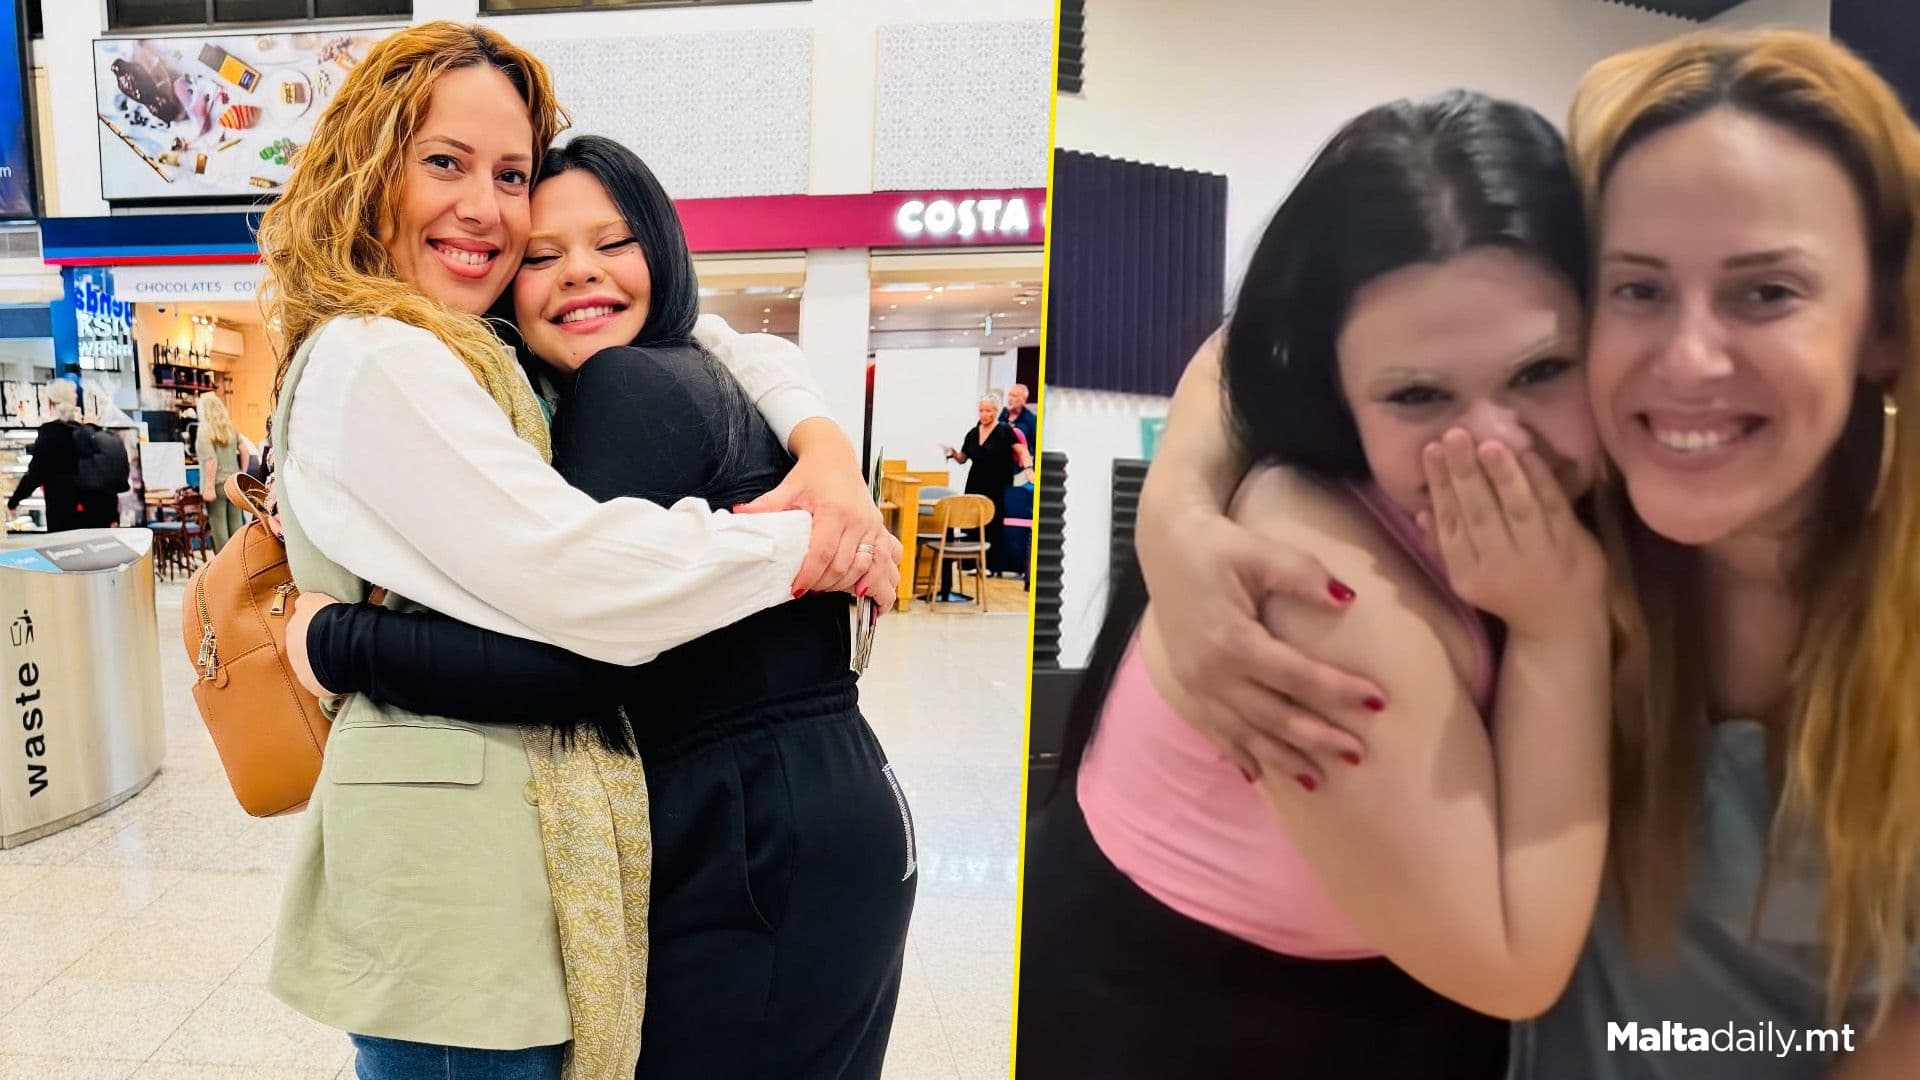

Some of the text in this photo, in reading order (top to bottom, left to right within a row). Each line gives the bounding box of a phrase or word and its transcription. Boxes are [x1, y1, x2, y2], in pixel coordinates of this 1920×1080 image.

[897, 198, 1030, 236] COSTA
[136, 281, 222, 293] CHOCOLATES
[16, 661, 48, 797] waste
